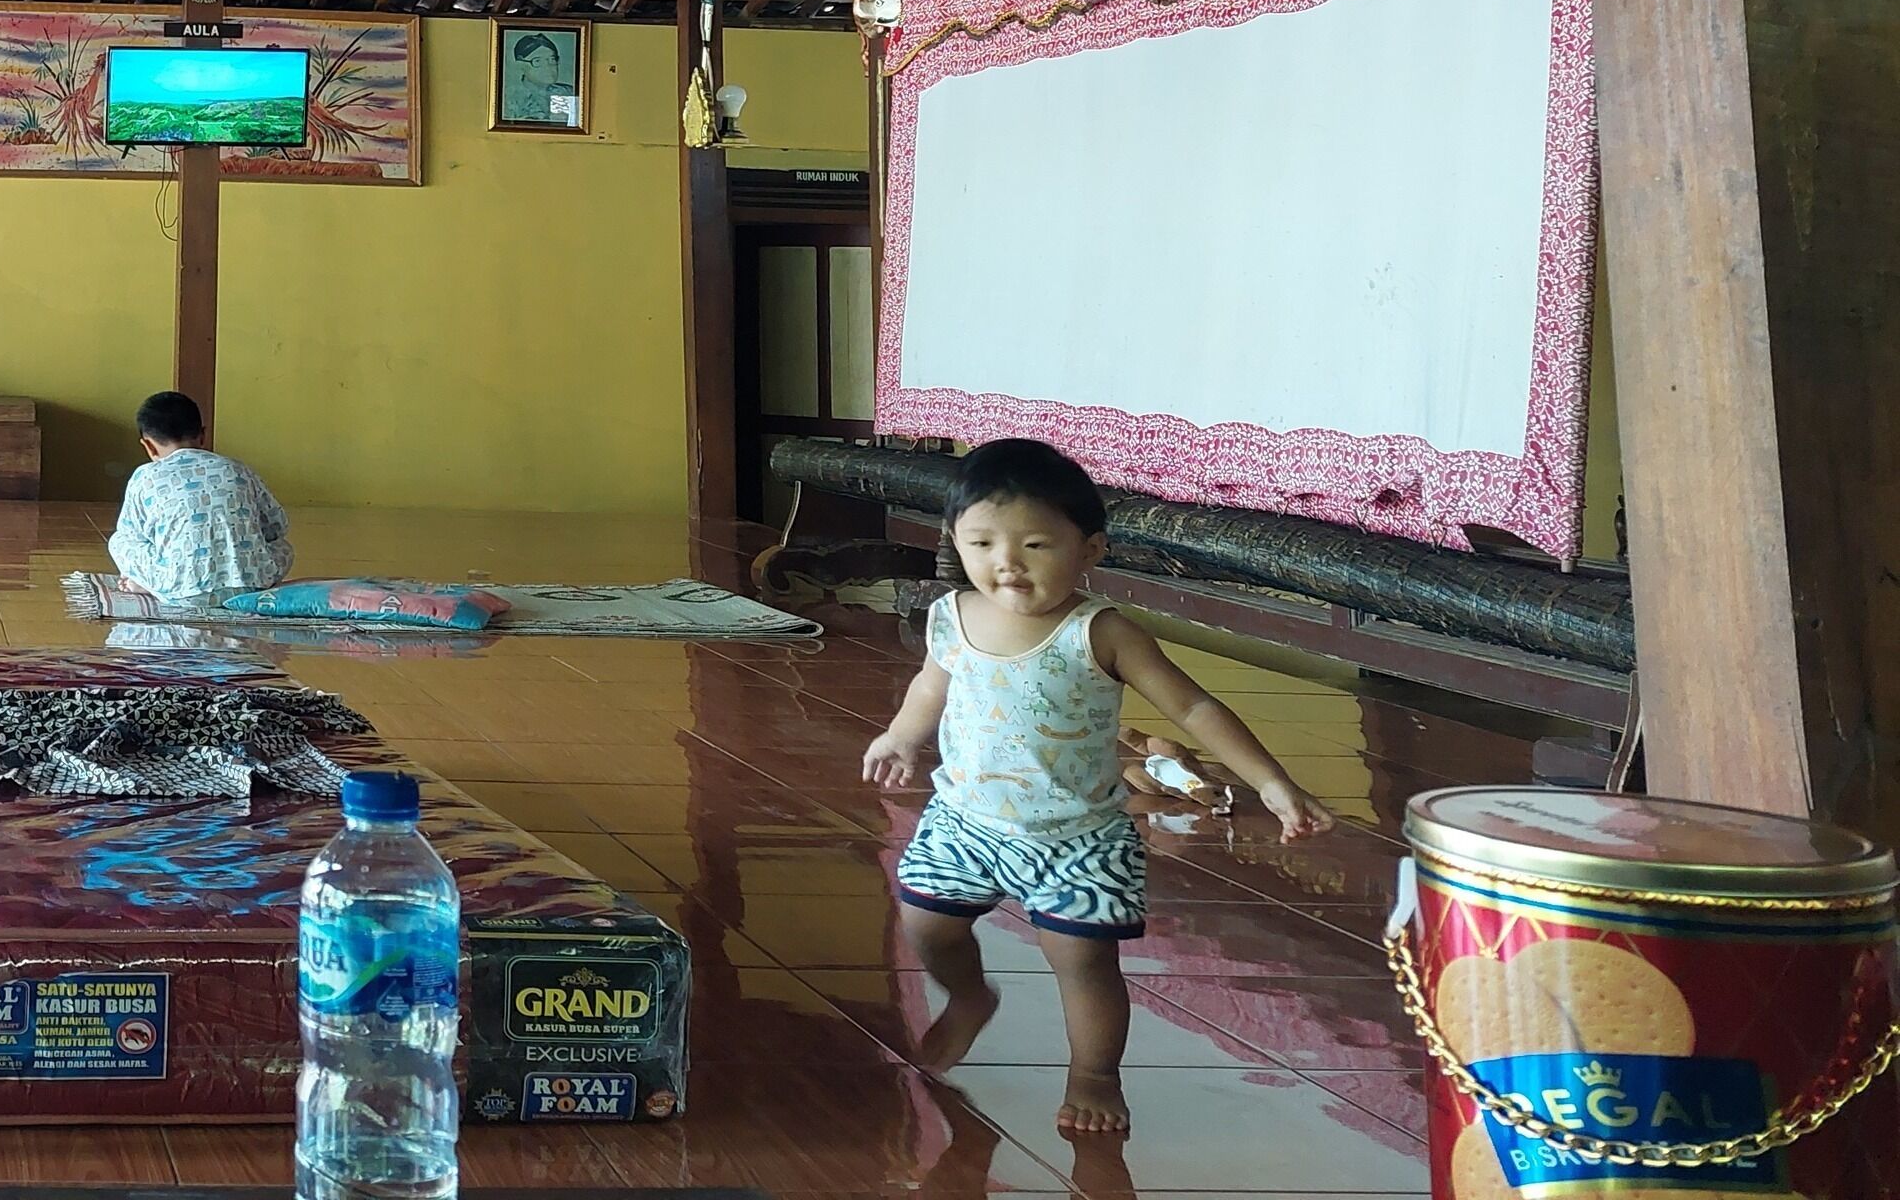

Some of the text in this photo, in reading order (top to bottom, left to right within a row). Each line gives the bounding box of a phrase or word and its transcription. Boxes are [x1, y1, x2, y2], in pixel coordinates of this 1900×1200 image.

[183, 24, 219, 37] AULA
[796, 171, 860, 182] RUMAH INDUK
[299, 931, 349, 973] QUA
[37, 983, 156, 996] SATU-SATUNYA
[36, 999, 157, 1013] KASUR BUSA
[515, 987, 650, 1022] GRAND
[36, 1016, 59, 1026] ANTI
[525, 1023, 640, 1034] KASUR BUSA SUPER
[58, 1038, 86, 1047] KUTU
[526, 1046, 638, 1063] EXCLUSIVE
[532, 1078, 625, 1096] ROYAL
[539, 1096, 618, 1113] FOAM
